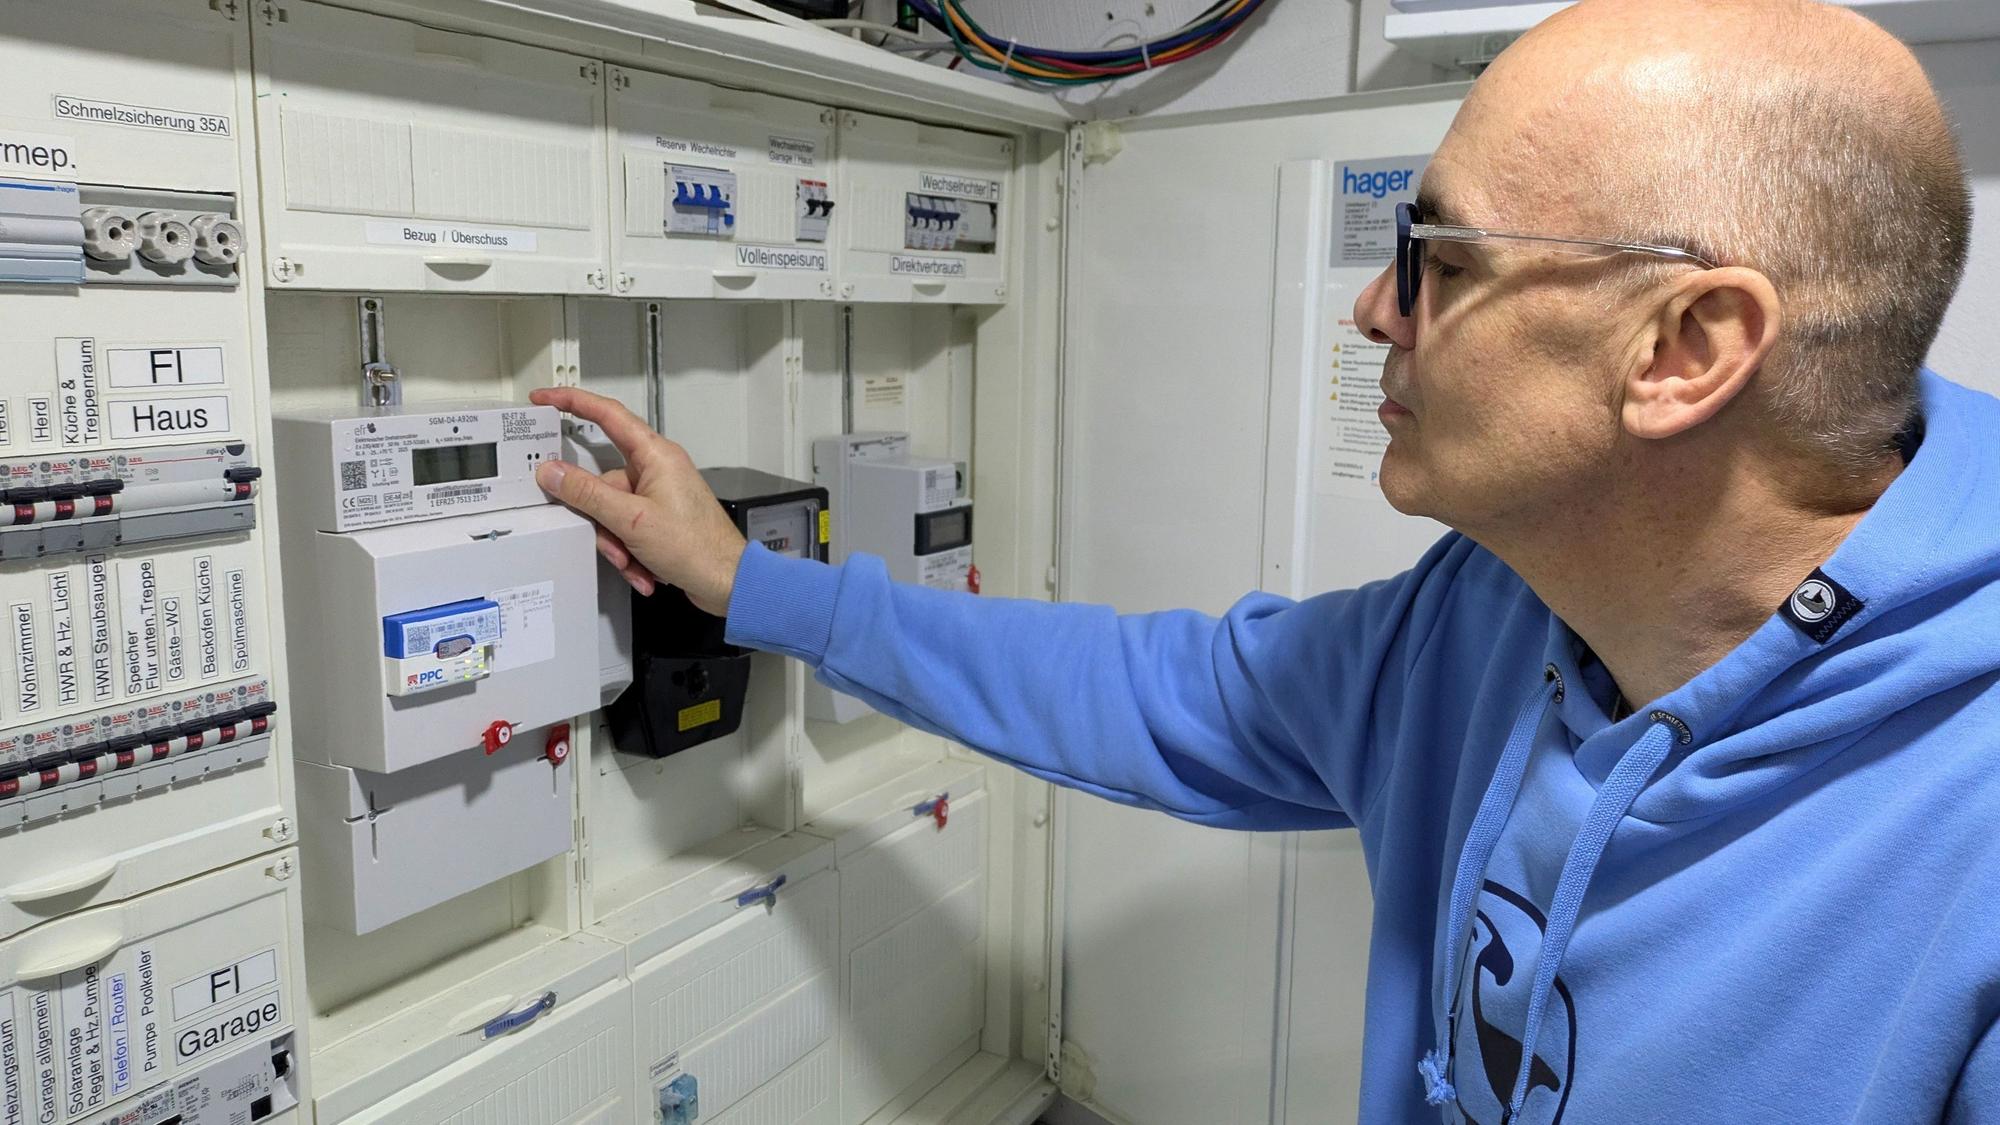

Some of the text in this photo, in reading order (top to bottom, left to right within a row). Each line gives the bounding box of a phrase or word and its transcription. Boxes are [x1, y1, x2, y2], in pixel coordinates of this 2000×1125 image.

[57, 99, 228, 134] Schmelzsicherung 35A
[0, 143, 76, 171] mep.
[656, 136, 687, 151] Reserve
[921, 174, 987, 195] Wechselrichter
[1343, 166, 1414, 199] hager
[403, 228, 508, 246] Bezug / Überschuss
[738, 247, 825, 270] Volleinspeisung
[892, 256, 963, 274] Direktverbrauch
[150, 350, 183, 384] FI
[61, 379, 80, 444] Küche &
[81, 340, 100, 444] Treppenraum
[32, 401, 49, 439] Herd
[132, 404, 209, 433] Haus
[53, 573, 76, 702] HWR & Hz. Licht
[92, 559, 111, 696] HWR Staubsauger
[197, 560, 216, 674] Backofen Küche
[230, 572, 248, 670] Spülmaschine
[18, 606, 37, 709] Wohnzimmer
[127, 630, 143, 694] Speicher
[145, 662, 159, 690] Flur
[419, 668, 443, 685] PPC
[112, 978, 126, 1026] Router
[210, 964, 241, 1003] FI
[138, 950, 158, 1072] Pumpe Poolkeller
[178, 1002, 278, 1057] Garage
[0, 1018, 20, 1125] Heizungsraum
[33, 993, 56, 1124] Garage allgemein
[67, 1027, 84, 1115] Solaranlage
[86, 1042, 100, 1056] &
[114, 1036, 130, 1092] Telefon
[88, 1058, 104, 1107] Regler
